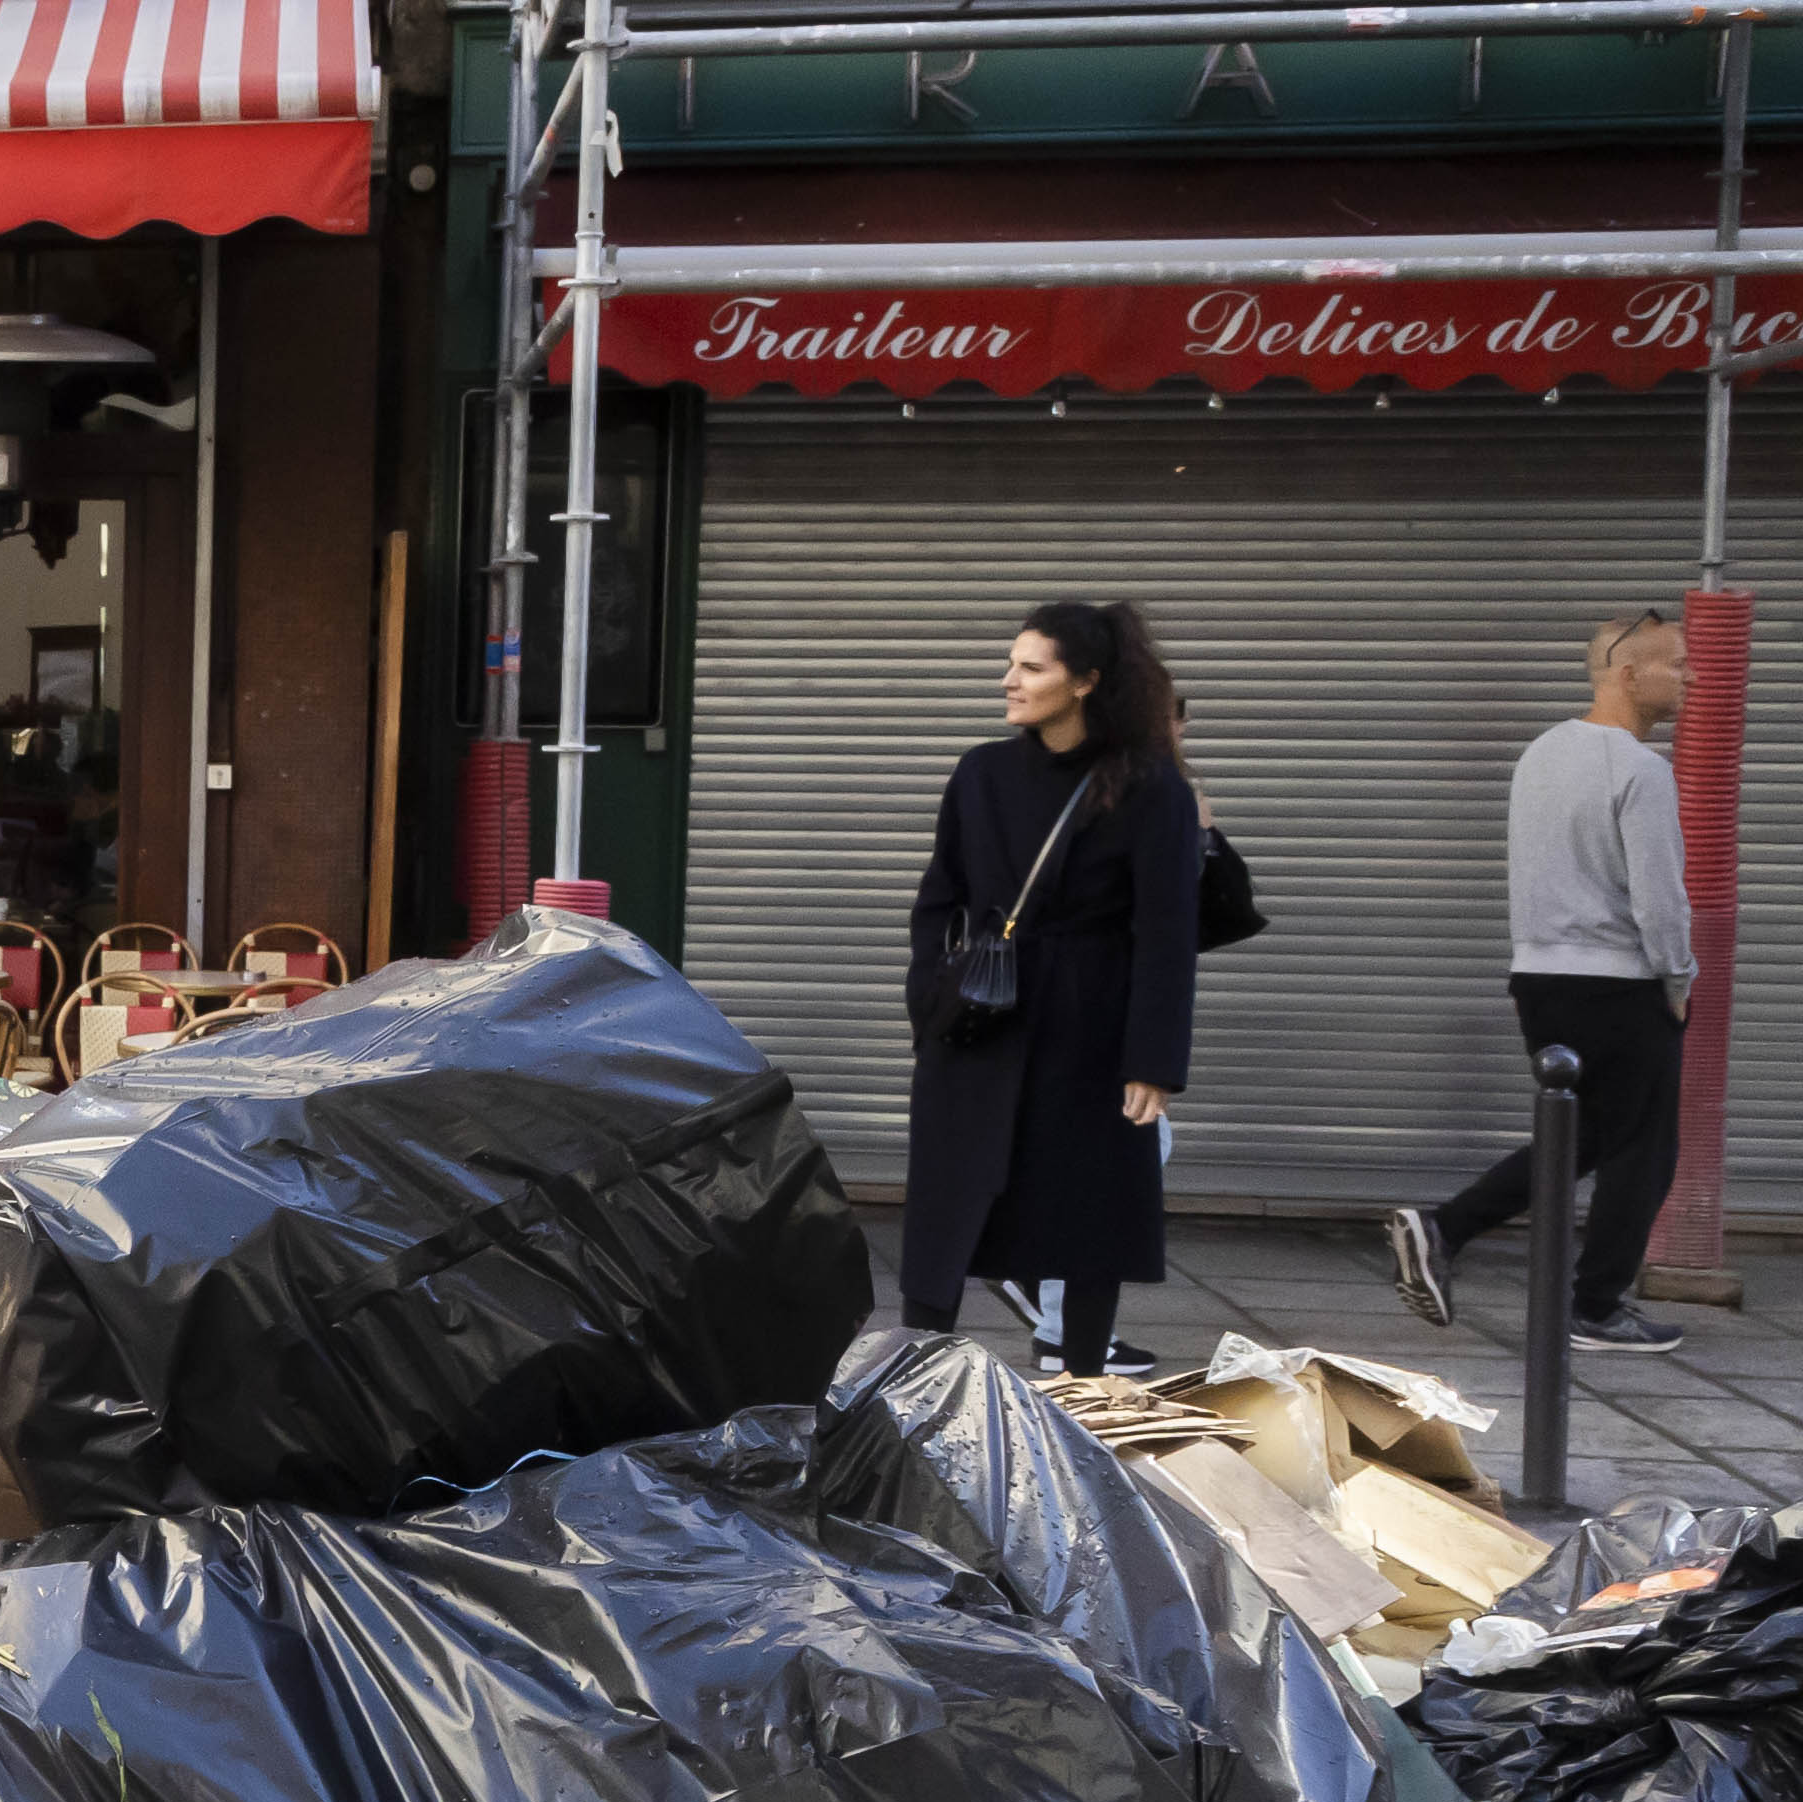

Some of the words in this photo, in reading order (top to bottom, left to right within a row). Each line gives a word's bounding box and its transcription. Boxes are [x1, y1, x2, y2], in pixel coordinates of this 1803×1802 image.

[695, 297, 1030, 361] Traiteur
[1184, 289, 1483, 357] Delices
[1486, 290, 1598, 354] de
